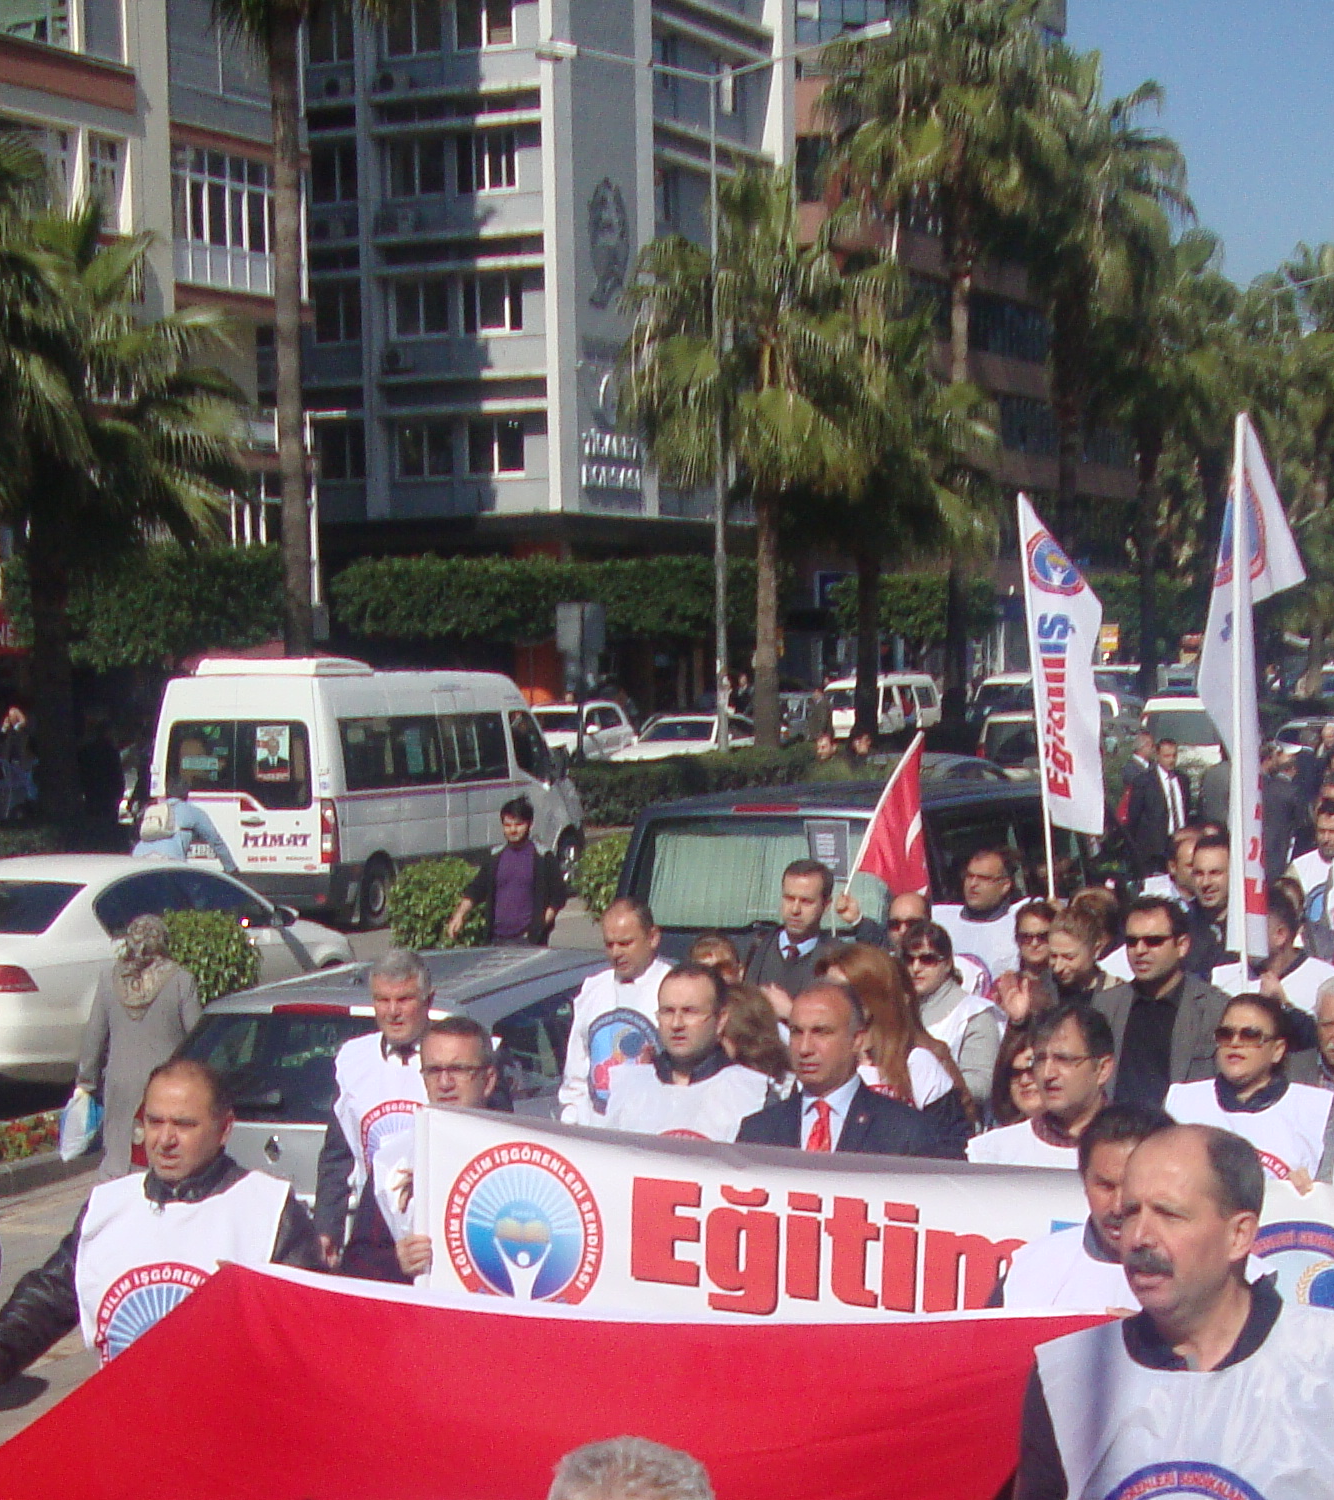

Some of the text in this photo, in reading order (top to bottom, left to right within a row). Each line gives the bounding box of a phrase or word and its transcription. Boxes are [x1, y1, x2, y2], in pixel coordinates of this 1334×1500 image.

[451, 1194, 465, 1215] VE
[459, 1156, 493, 1194] BİLİM
[575, 1200, 601, 1290] SENDİKASI
[631, 1176, 1029, 1316] Eğitim
